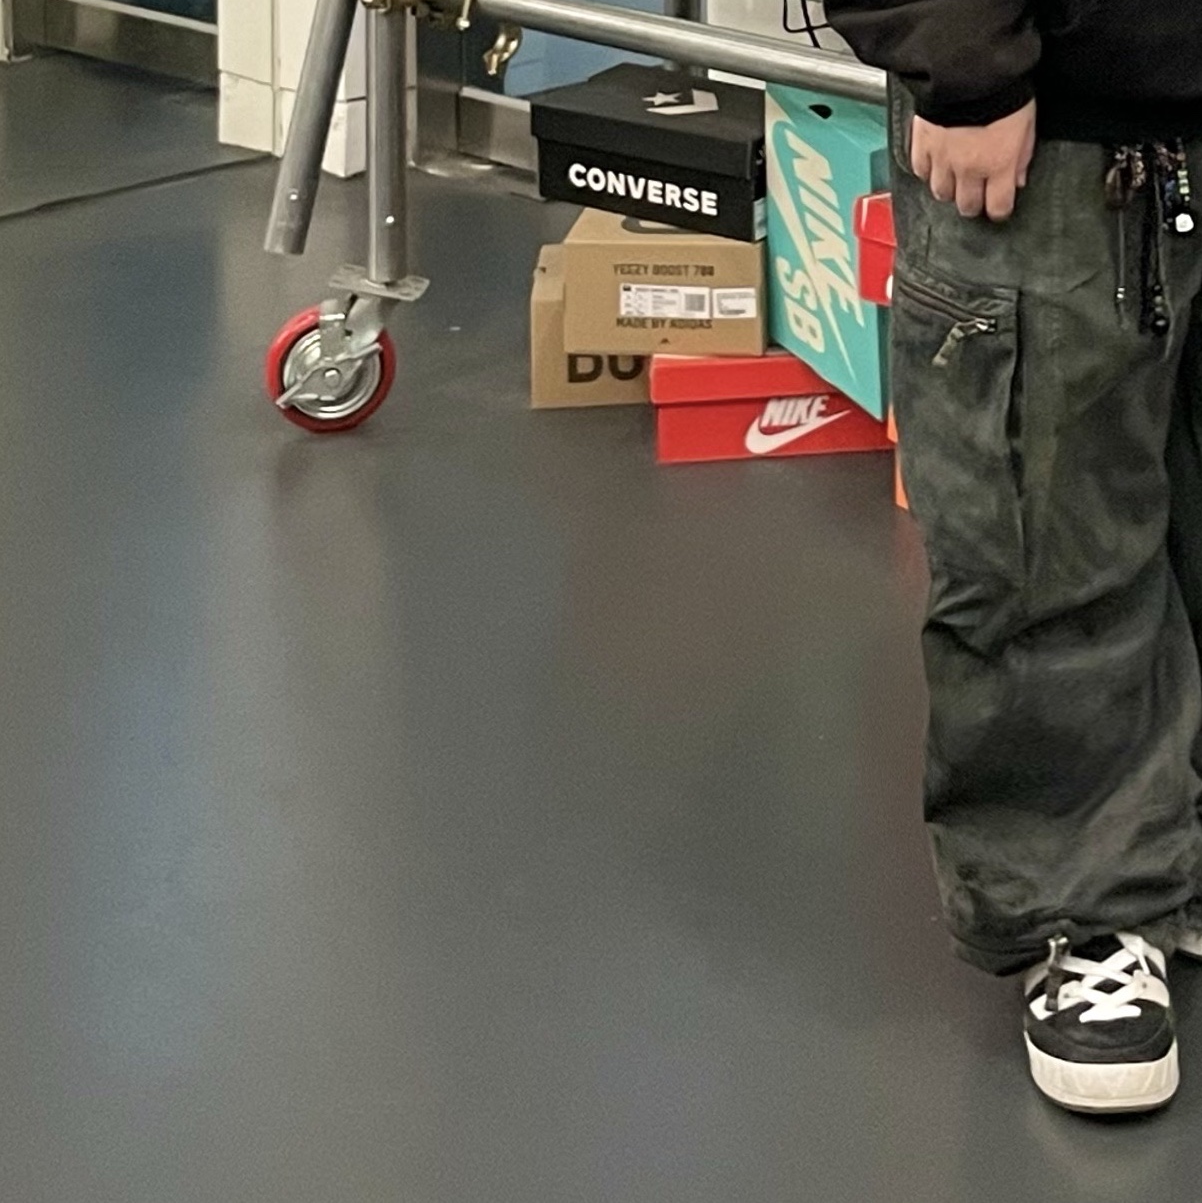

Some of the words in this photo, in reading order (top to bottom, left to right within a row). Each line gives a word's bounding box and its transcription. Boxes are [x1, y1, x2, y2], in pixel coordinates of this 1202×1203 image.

[568, 163, 718, 216] CONVERSE
[784, 128, 865, 328] NIKE
[759, 394, 830, 429] NIKE
